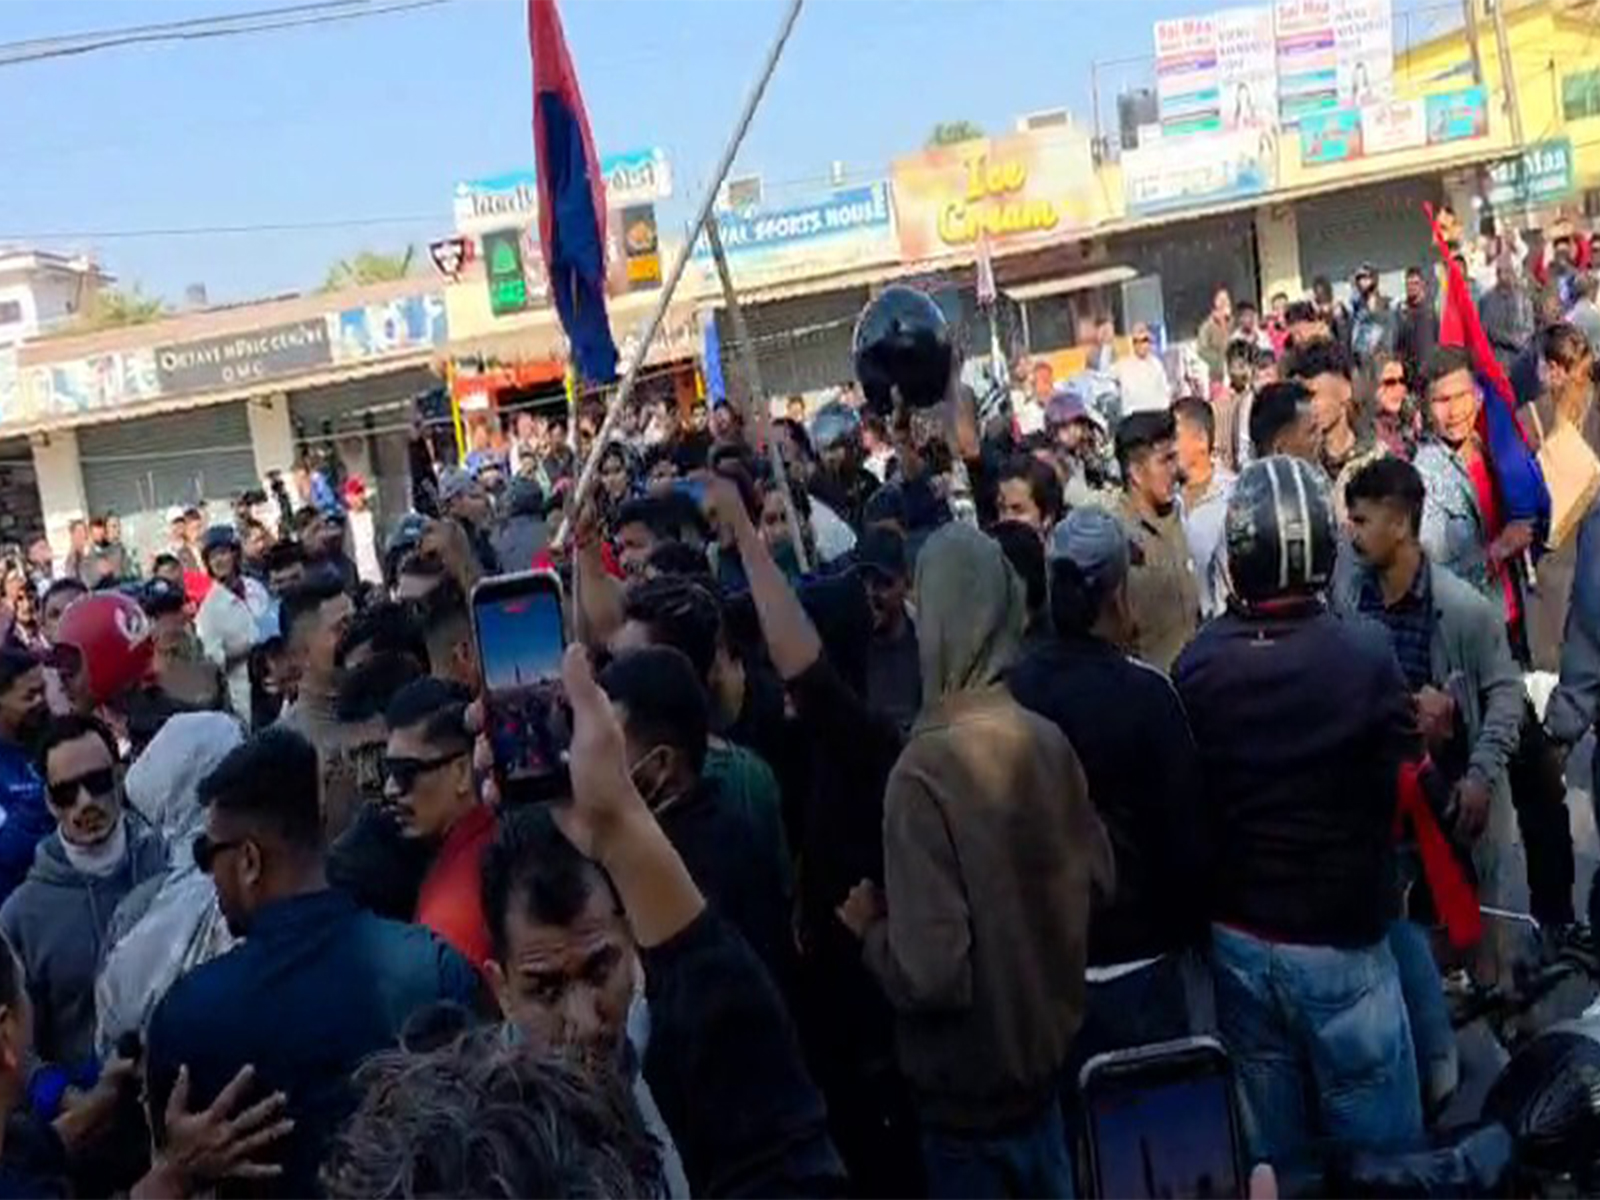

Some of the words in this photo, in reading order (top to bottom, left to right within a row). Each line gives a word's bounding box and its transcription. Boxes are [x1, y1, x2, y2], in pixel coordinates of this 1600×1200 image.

[963, 155, 1026, 203] Ice
[825, 199, 887, 228] HOUSE
[937, 199, 1059, 246] Cream
